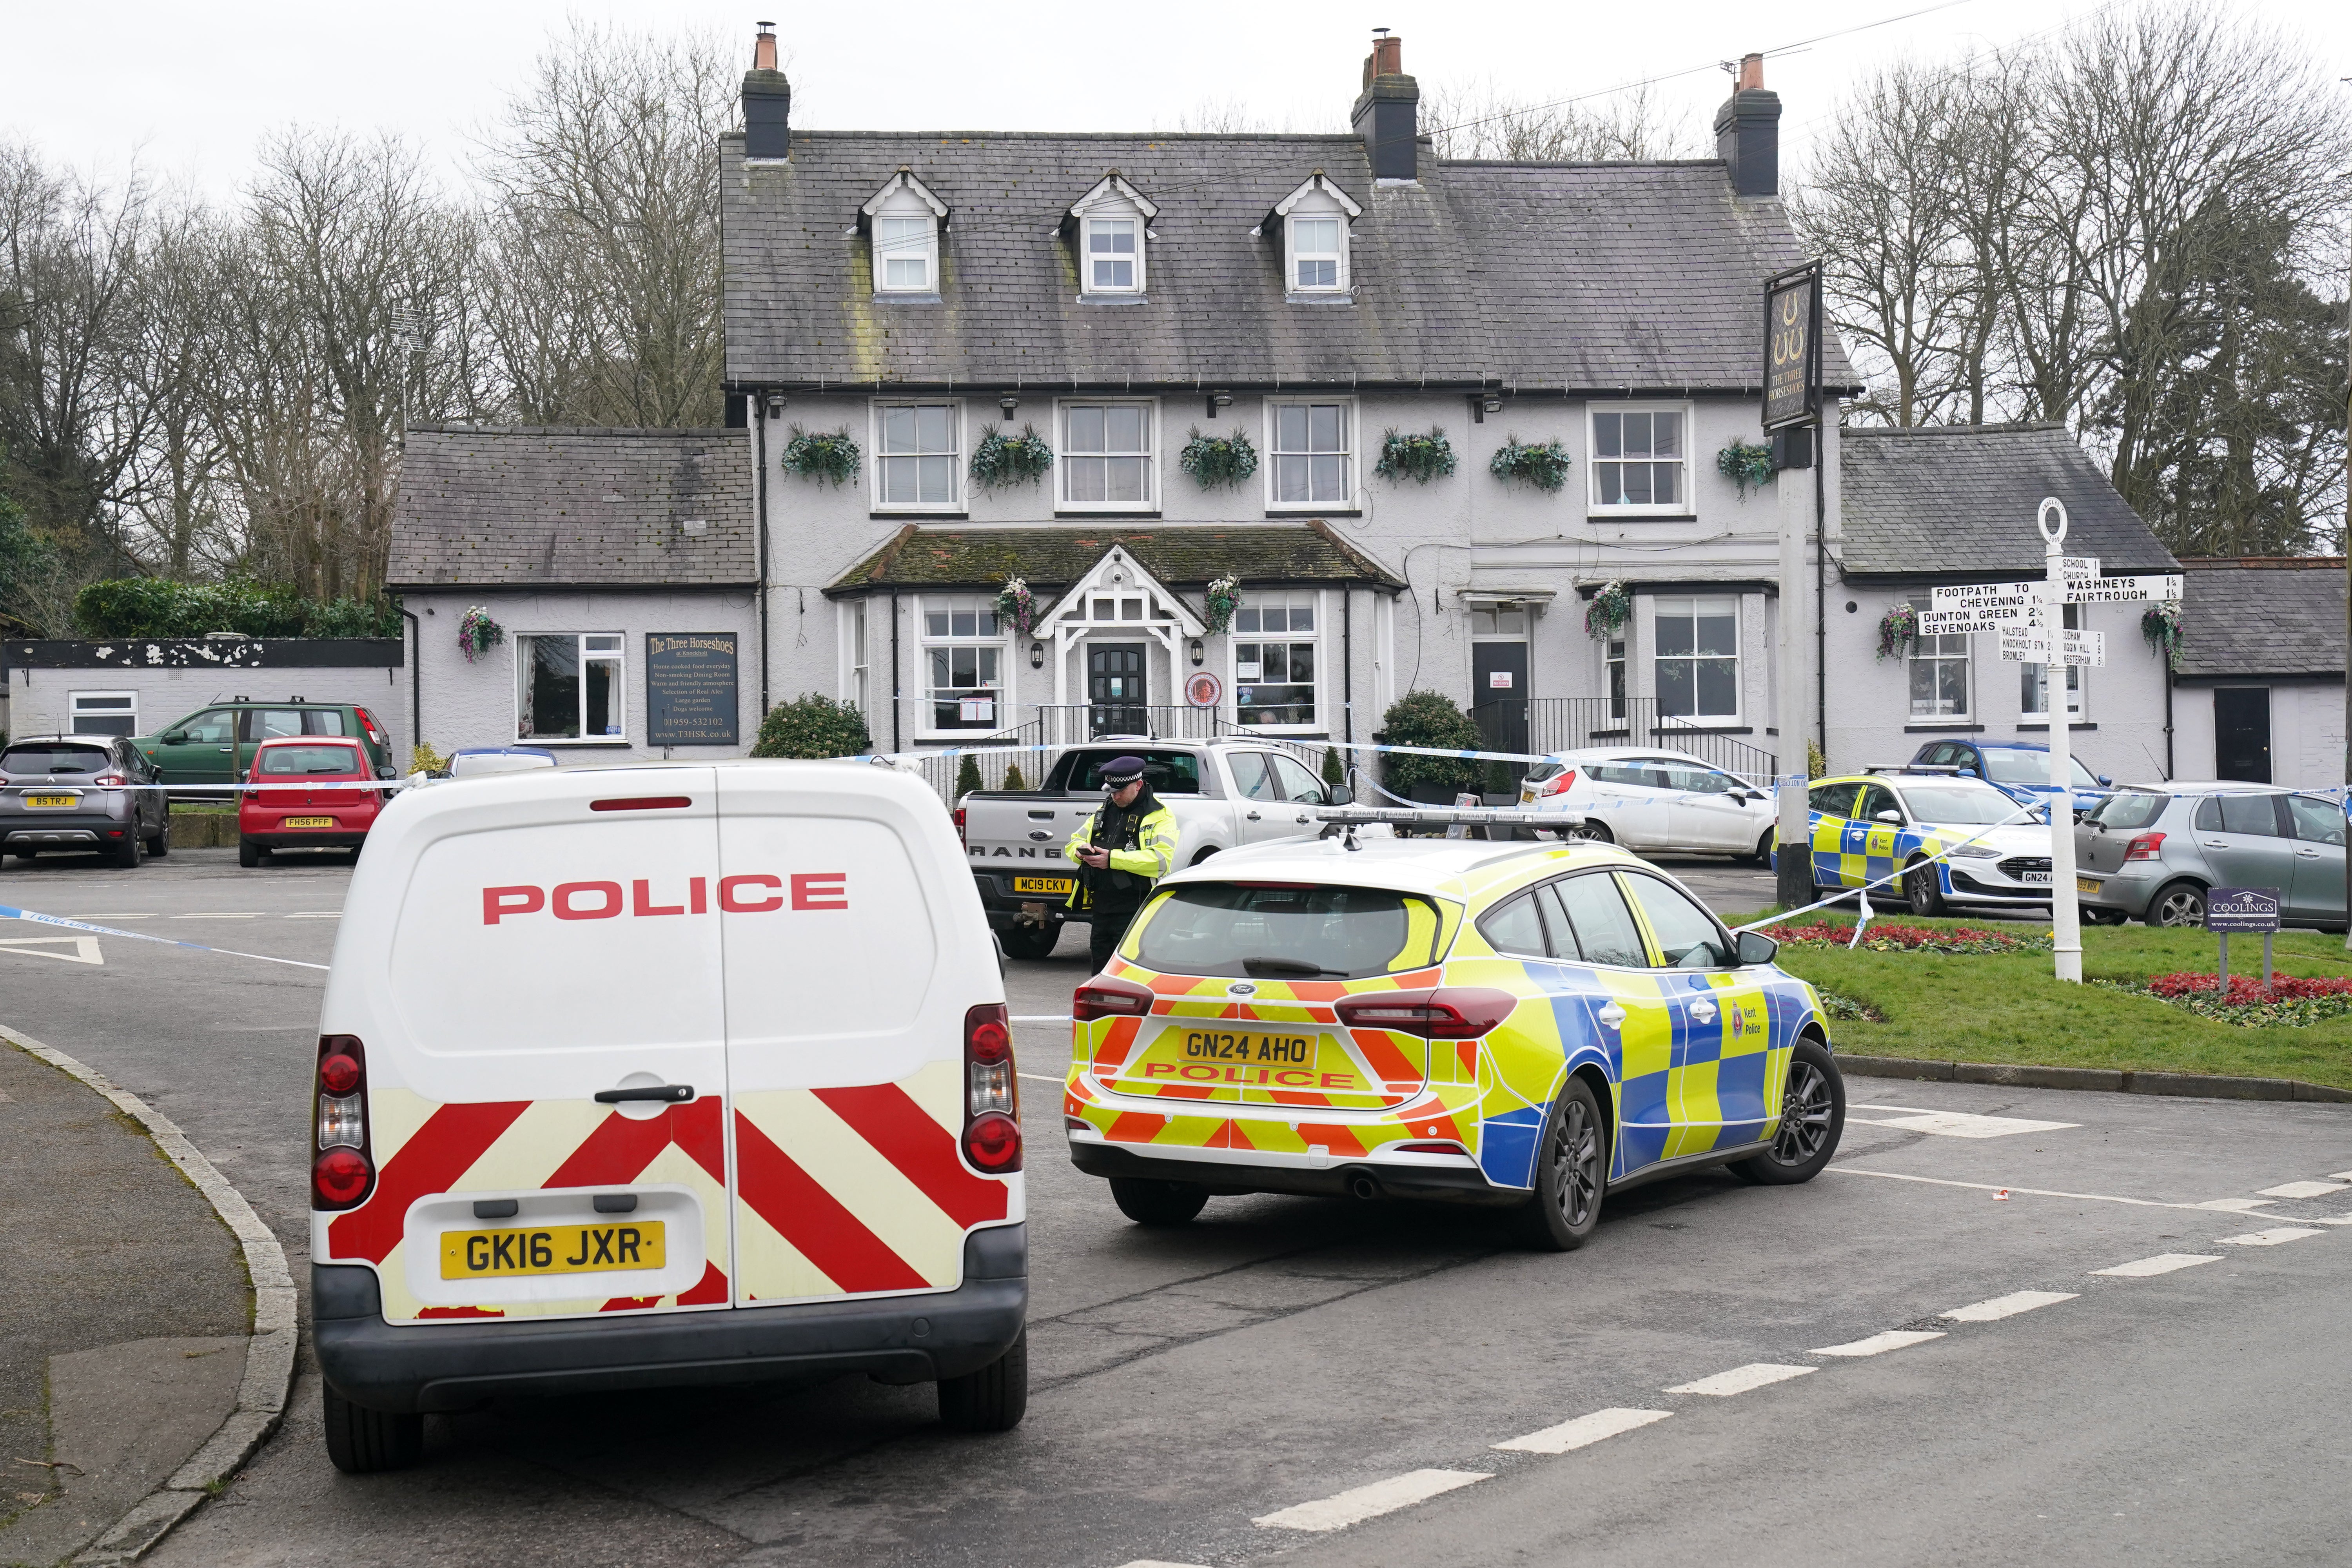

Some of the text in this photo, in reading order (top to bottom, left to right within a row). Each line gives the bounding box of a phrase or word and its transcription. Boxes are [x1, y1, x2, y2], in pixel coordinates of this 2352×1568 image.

[1772, 367, 1803, 387] THE THREE
[1769, 380, 1804, 401] HORSESHOES
[2042, 499, 2064, 512] KNOCKHOLT
[2063, 559, 2097, 570] SCHOOL 1
[2063, 571, 2088, 579] CHURCH
[1937, 584, 2029, 597] FOOTPATH TO
[2067, 579, 2135, 590] WASHNEYS
[1960, 596, 2024, 608] CHEVENING
[2067, 590, 2147, 602] FAIRTROUGH
[1924, 611, 1970, 622] DUNTON
[1979, 608, 2017, 619] GREEN
[1925, 622, 1995, 633] SEVENOAKS
[2002, 626, 2028, 637] HALSTEAD
[2097, 633, 2101, 642] 3
[650, 637, 734, 655] The Three Horseshoes
[2003, 639, 2031, 650] KNOCKHOLT
[2034, 641, 2044, 650] STN
[2080, 643, 2090, 653] HILL
[2098, 645, 2101, 654] 5
[2003, 650, 2051, 662] BROMLEY 9
[969, 846, 1062, 858] RANG
[2026, 873, 2048, 882] GN24
[1021, 879, 1065, 891] MC19 CKV
[2077, 879, 2098, 891] O59 WRK
[484, 873, 849, 925] POLICE
[2213, 903, 2274, 912] COOLINGS
[1232, 984, 1250, 993] Ford
[1744, 1007, 1756, 1020] Kent
[1745, 1023, 1760, 1036] Police
[1187, 1033, 1306, 1063] GN24 AHO
[1145, 1062, 1354, 1089] POLICE
[467, 1228, 641, 1271] GK16 JXR
